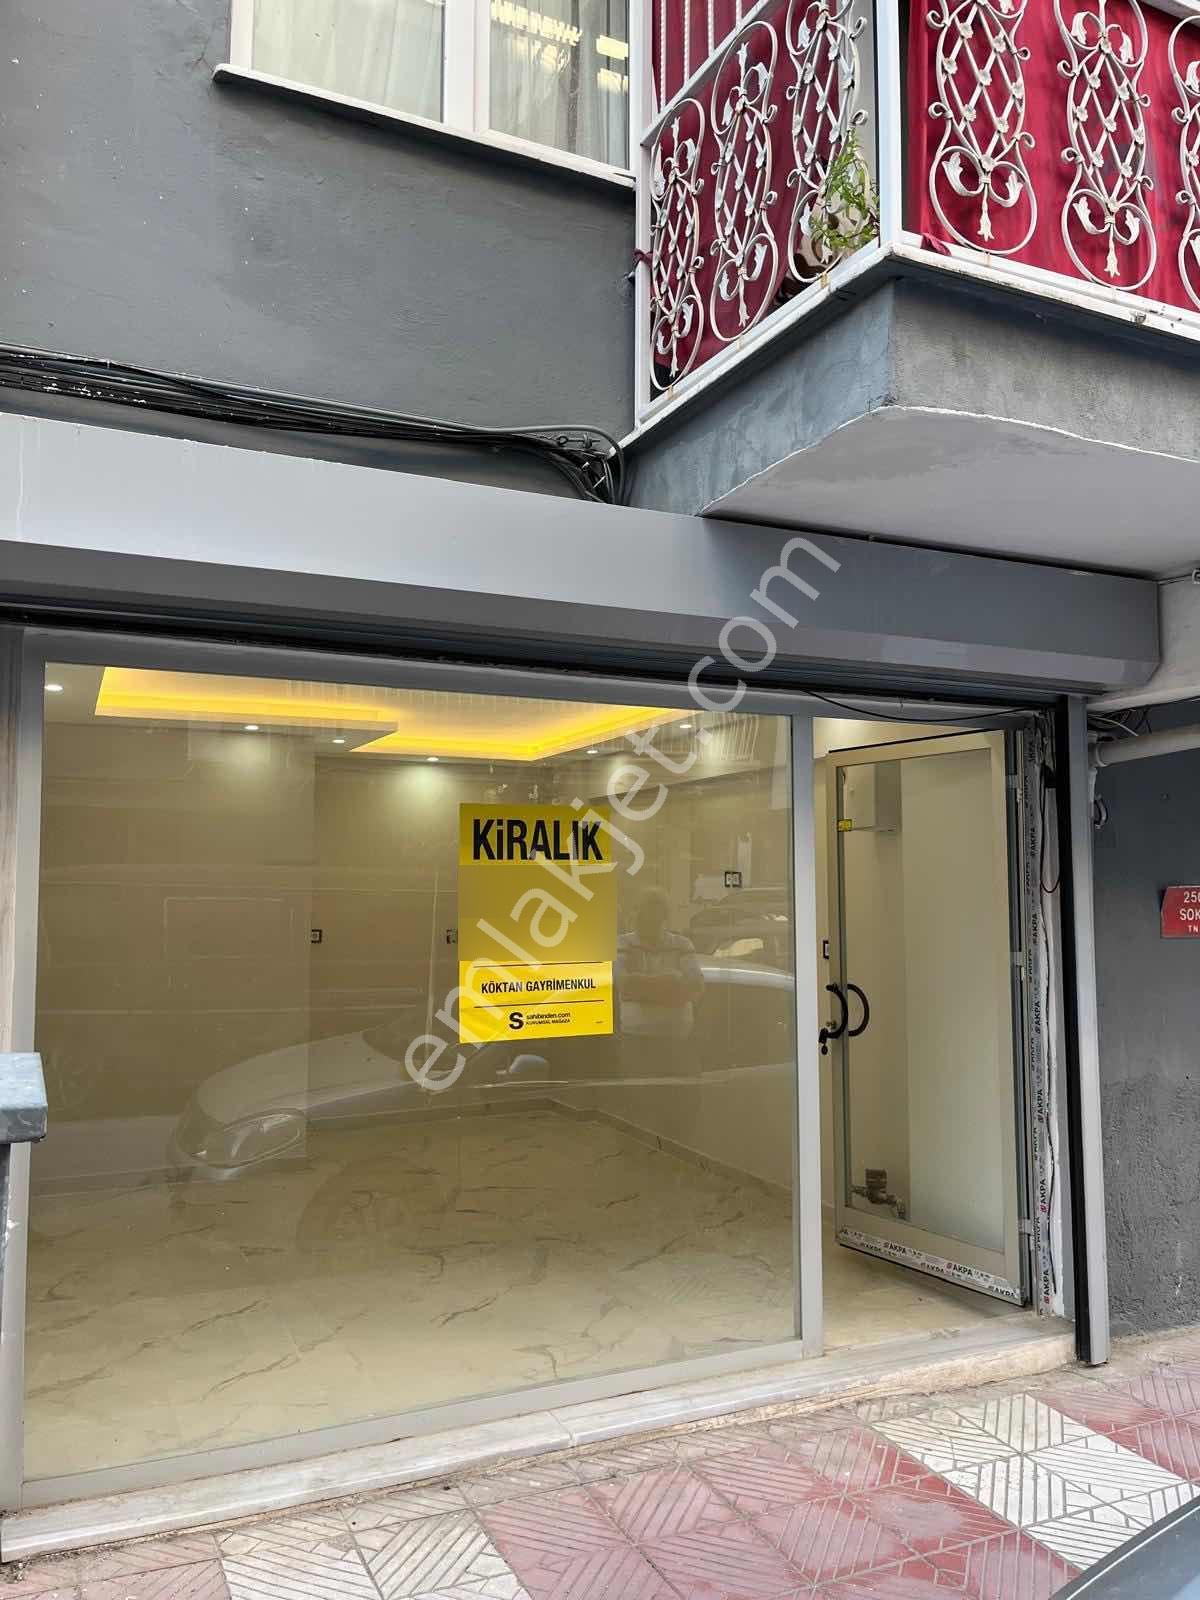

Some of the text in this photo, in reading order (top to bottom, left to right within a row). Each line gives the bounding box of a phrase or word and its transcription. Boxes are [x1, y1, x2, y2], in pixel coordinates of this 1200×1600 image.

[481, 977, 597, 994] KÖKTAN GAYRİMENKUL
[952, 1264, 973, 1277] AKPA
[1042, 1269, 1050, 1296] AKPA
